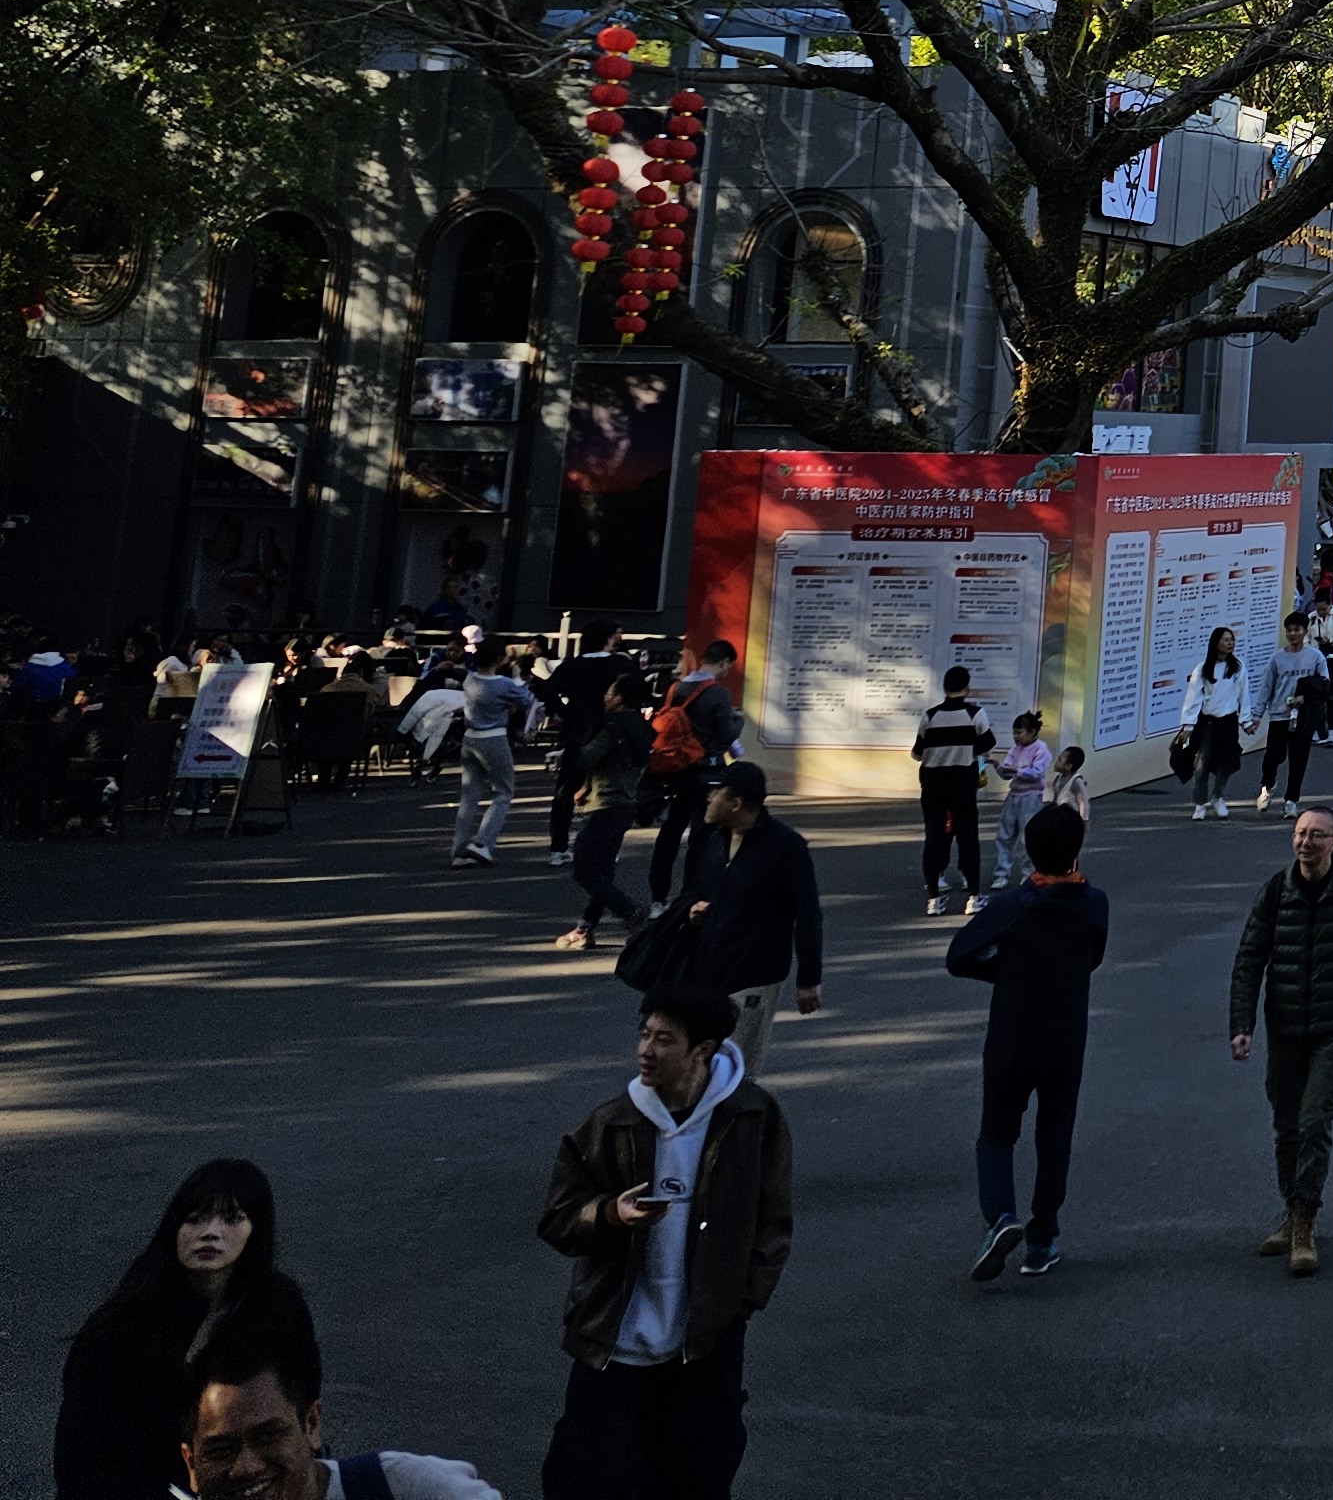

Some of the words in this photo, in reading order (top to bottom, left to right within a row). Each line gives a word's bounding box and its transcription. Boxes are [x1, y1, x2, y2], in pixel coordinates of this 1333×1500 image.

[782, 486, 1051, 503] 广东省中医院2024-2025年冬春季流行性感冒
[855, 504, 975, 519] 中医药居家防护指引
[859, 526, 969, 540] 治疗期食养指引
